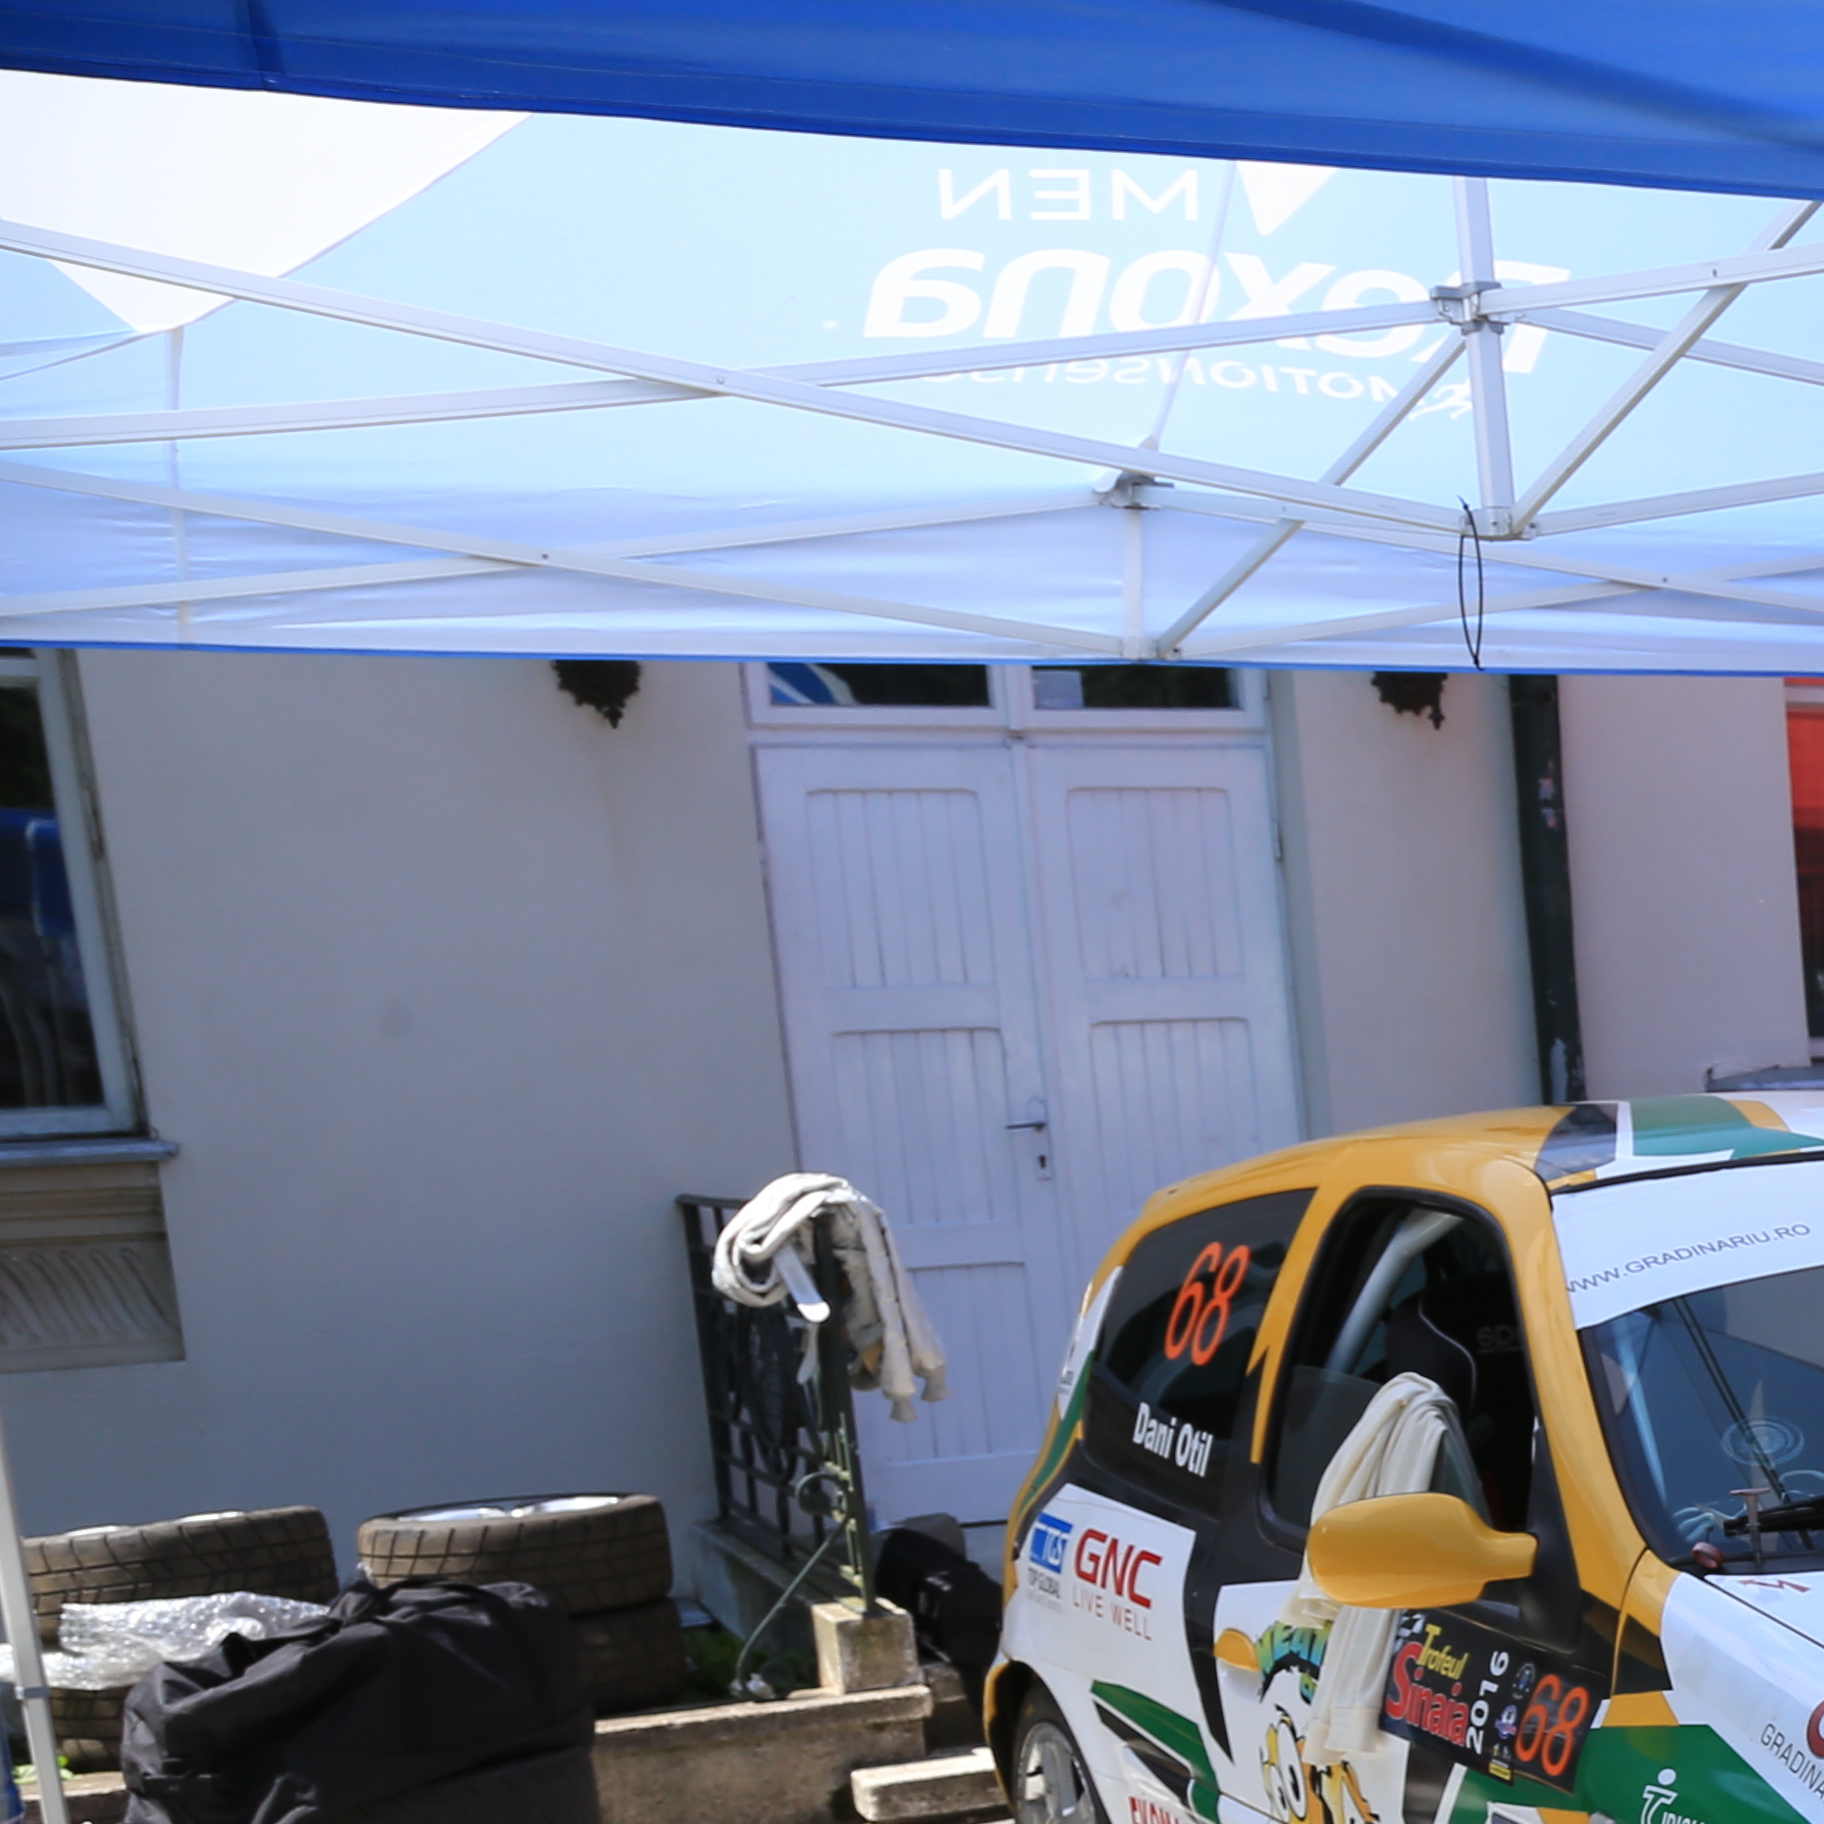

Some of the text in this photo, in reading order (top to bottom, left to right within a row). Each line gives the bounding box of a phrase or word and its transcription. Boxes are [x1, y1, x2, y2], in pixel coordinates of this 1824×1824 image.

[1163, 1241, 1251, 1365] 68
[1132, 1401, 1214, 1478] Dani Otil
[1072, 1585, 1104, 1618] LIVE
[1111, 1605, 1153, 1641] WELL
[1074, 1527, 1163, 1610] GNC
[1385, 1641, 1469, 1747] Sinaia
[1416, 1623, 1470, 1680] Trofeul
[1466, 1650, 1510, 1755] 2016
[1514, 1673, 1590, 1777] 68
